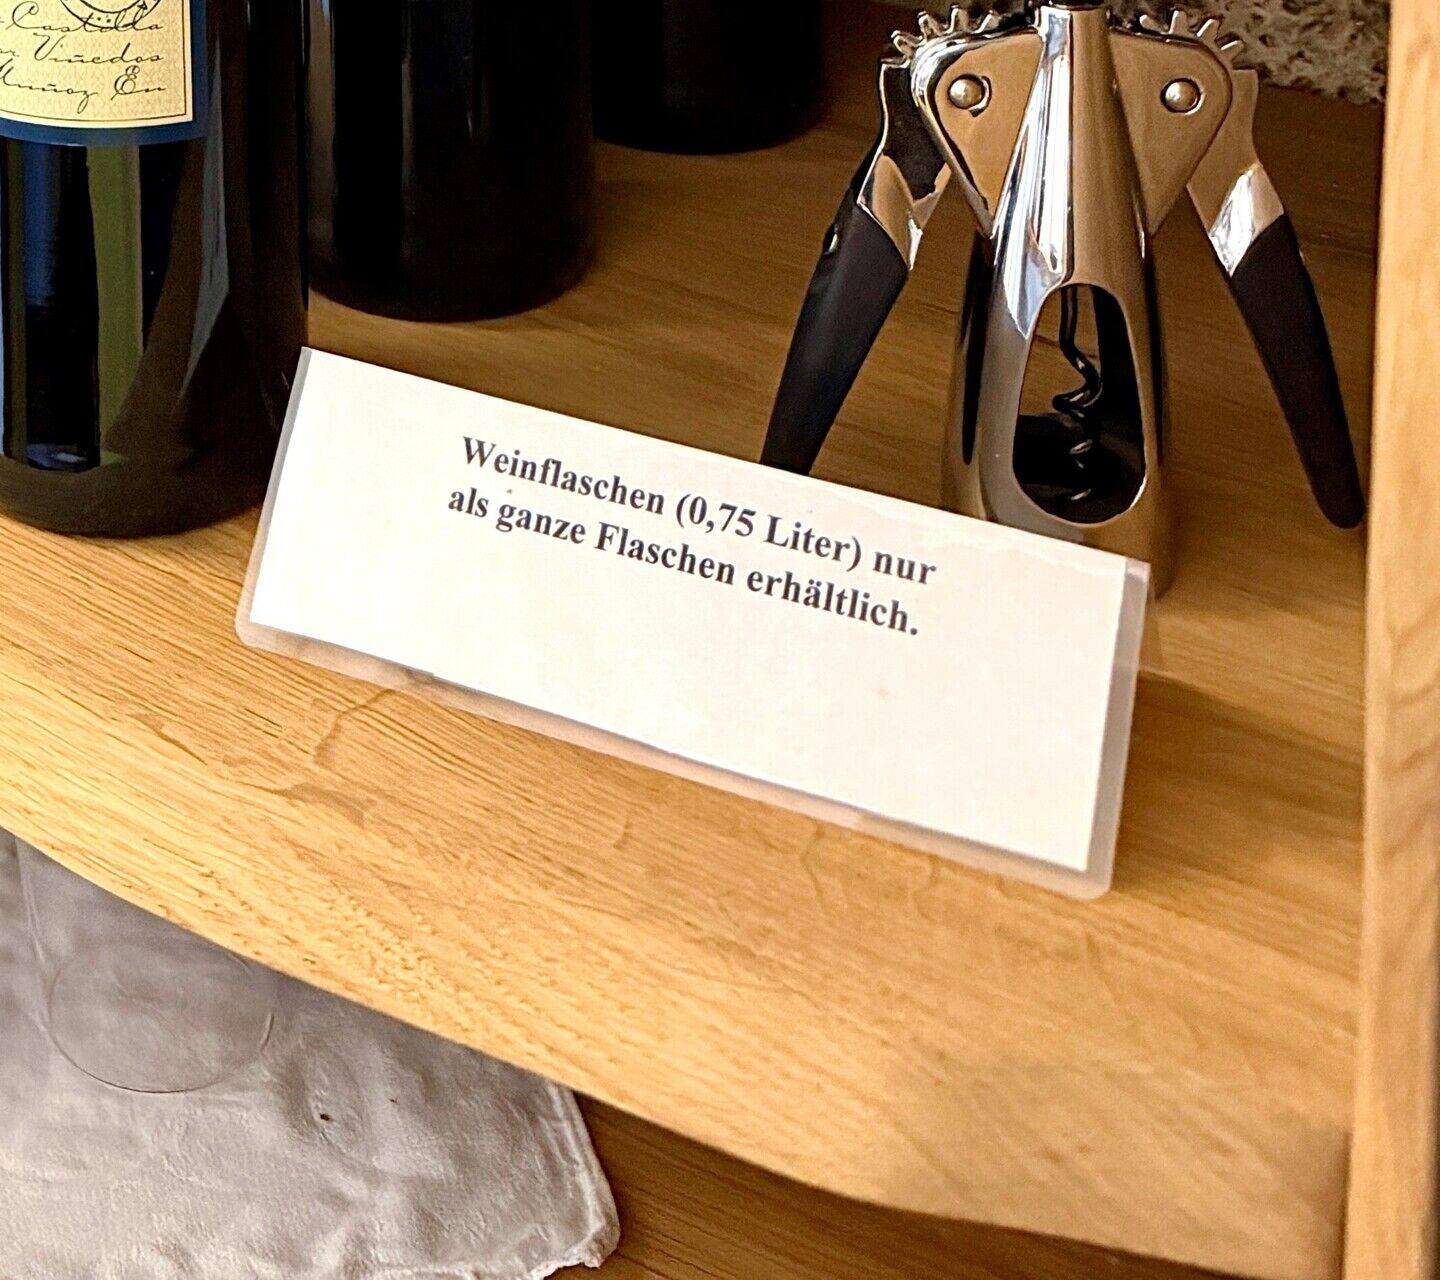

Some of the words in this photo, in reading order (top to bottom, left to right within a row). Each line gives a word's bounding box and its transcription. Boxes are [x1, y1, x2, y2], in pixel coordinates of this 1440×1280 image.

[32, 32, 164, 65] Viñedos
[447, 486, 490, 519] als
[495, 501, 587, 545] ganze
[593, 521, 736, 586] Flaschen
[746, 569, 919, 637] erhältlich.
[462, 435, 666, 516] Weinflaschen
[675, 493, 758, 538] (0,75
[762, 513, 862, 573] Liter)
[872, 549, 938, 585] nur
